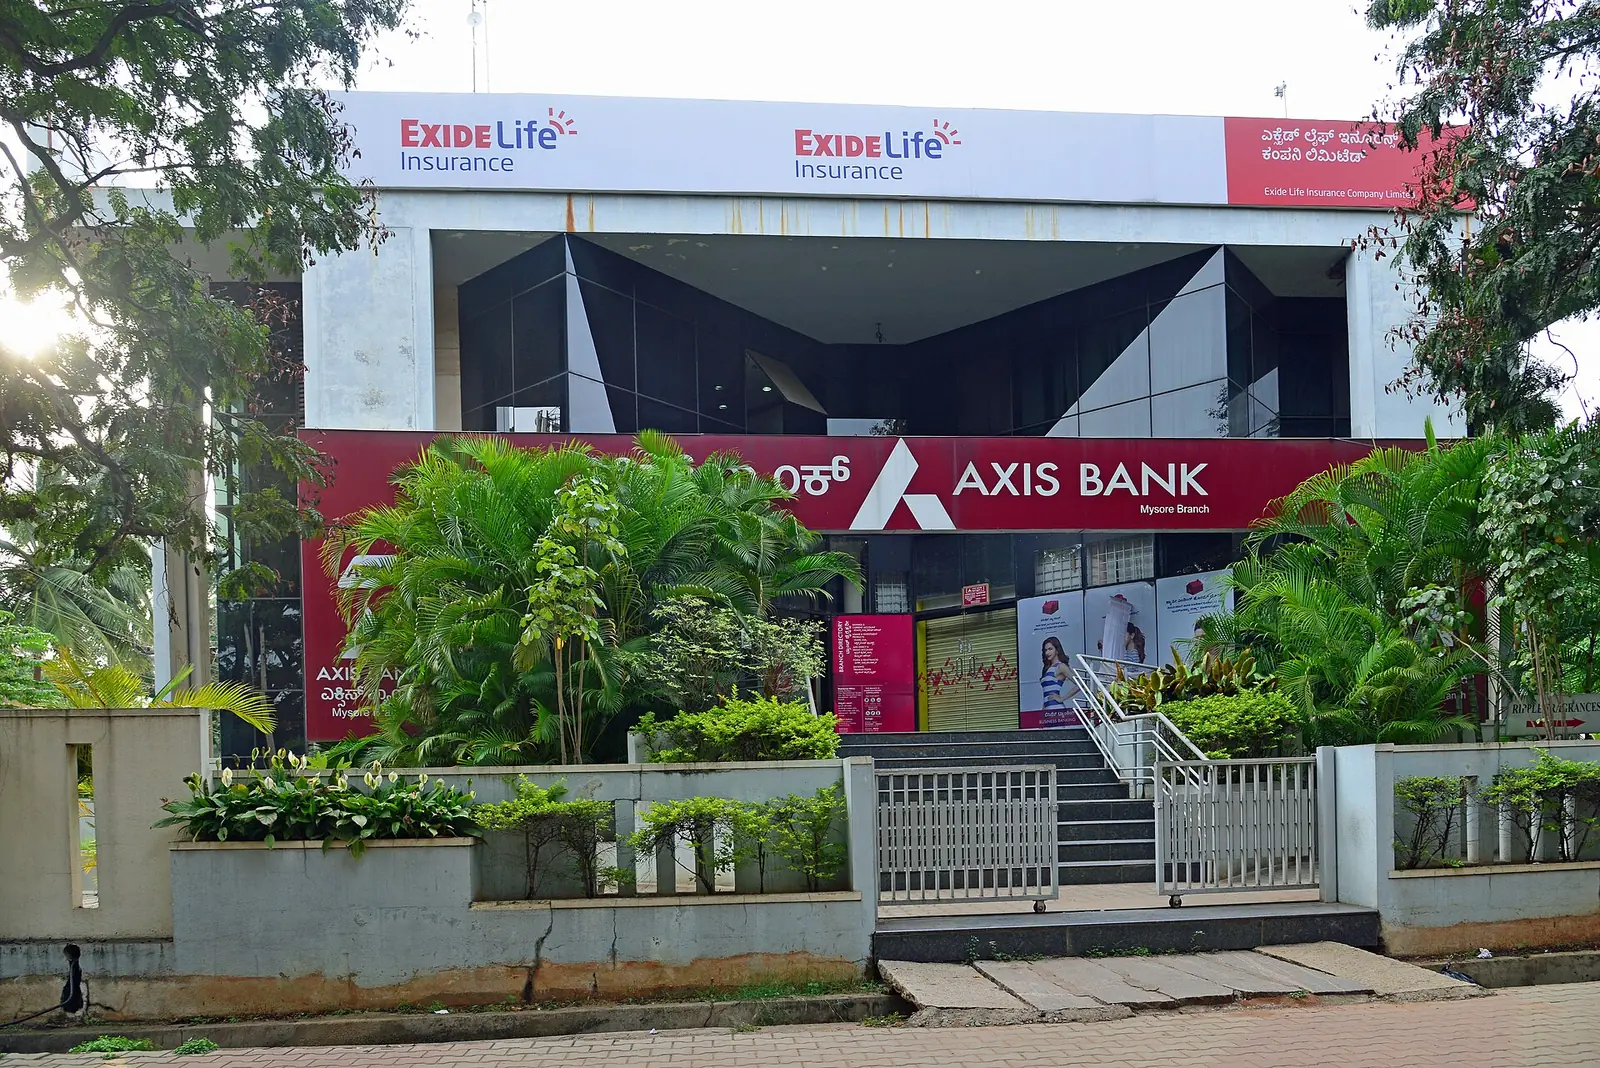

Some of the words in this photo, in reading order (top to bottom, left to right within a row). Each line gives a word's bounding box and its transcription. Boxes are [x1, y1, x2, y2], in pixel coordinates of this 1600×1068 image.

[401, 119, 490, 148] EXIDE
[496, 119, 557, 150] Life
[795, 129, 881, 158] EXIDE
[885, 130, 942, 160] Life
[401, 151, 514, 173] Insurance
[1261, 146, 1302, 162] ಕಂಪನಿ
[795, 160, 903, 181] Insurance
[1264, 187, 1287, 196] Exide
[1289, 187, 1305, 197] Life
[1306, 188, 1346, 198] Insurance
[1347, 188, 1384, 200] Company
[952, 460, 1060, 497] AXIS
[1080, 462, 1209, 497] BANK
[1140, 504, 1175, 516] Mysore
[1176, 504, 1210, 514] Branch
